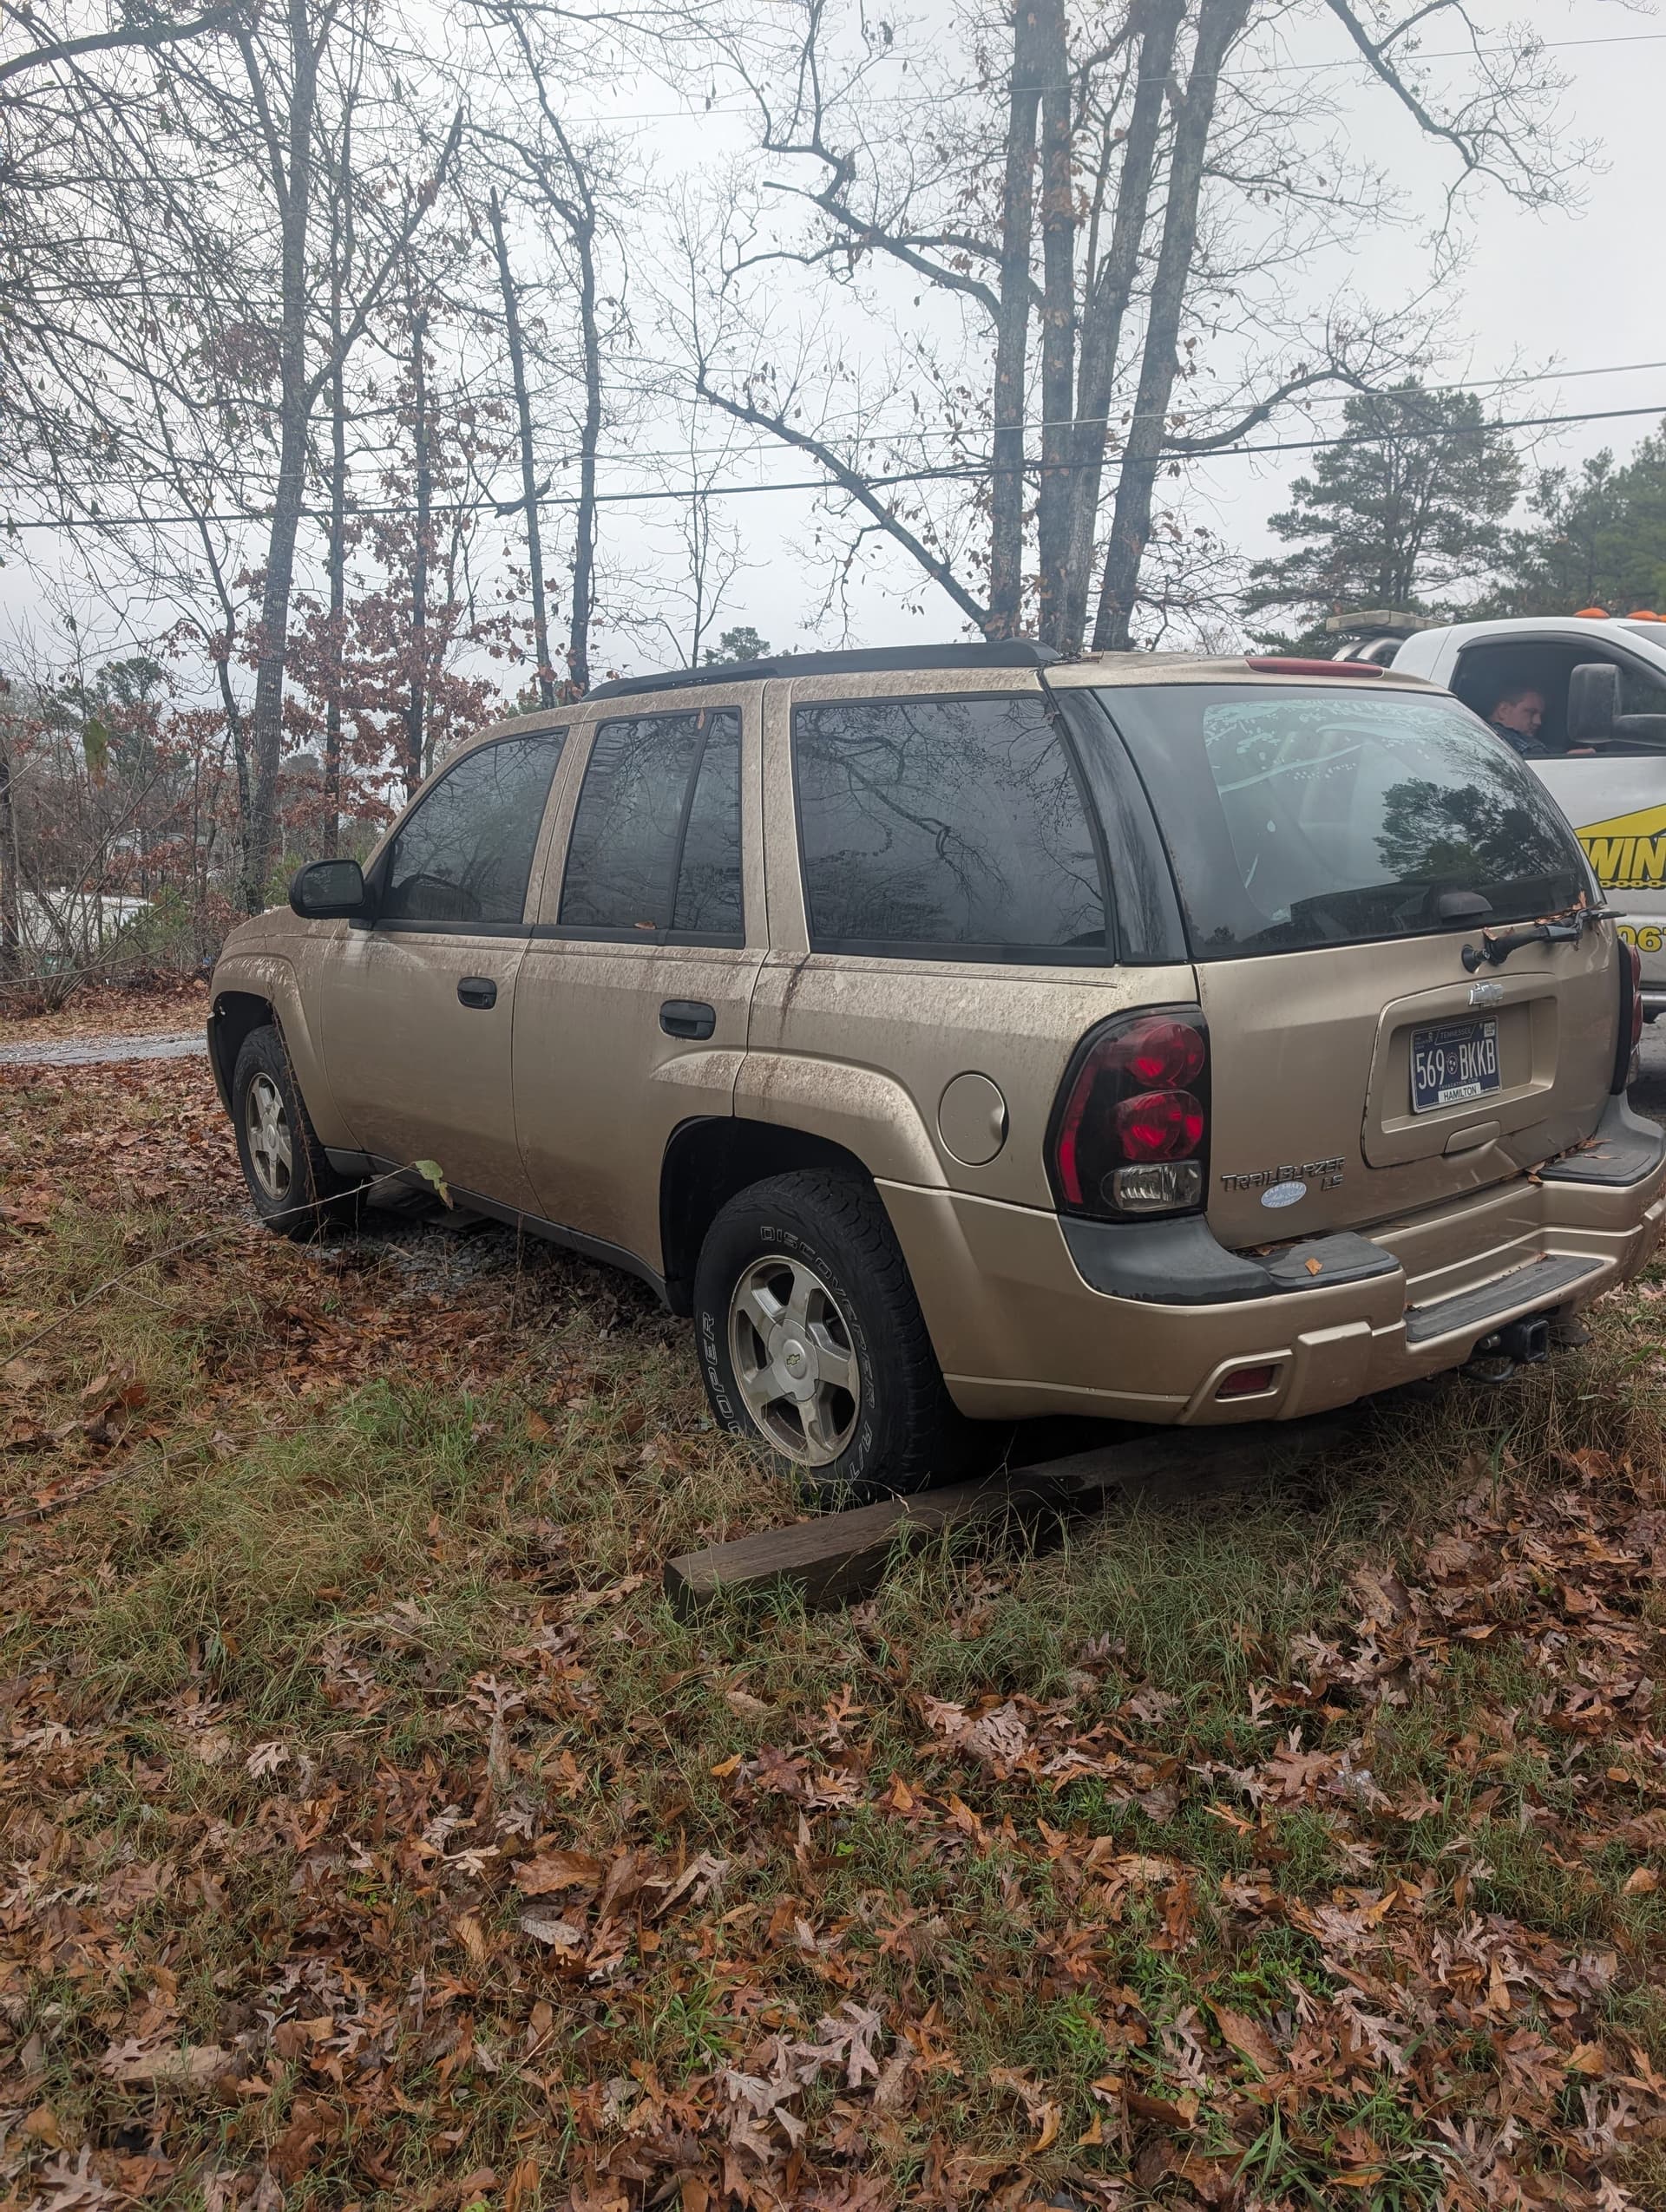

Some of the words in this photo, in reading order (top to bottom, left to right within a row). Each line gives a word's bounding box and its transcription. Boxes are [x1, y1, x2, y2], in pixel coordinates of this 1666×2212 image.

[1617, 925, 1666, 952] 06
[1440, 1025, 1473, 1039] TENNESSEE
[1415, 1048, 1446, 1090] 569
[1459, 1038, 1496, 1081] BKKB
[1443, 1085, 1477, 1101] HAMILTON
[1321, 1174, 1345, 1192] LS
